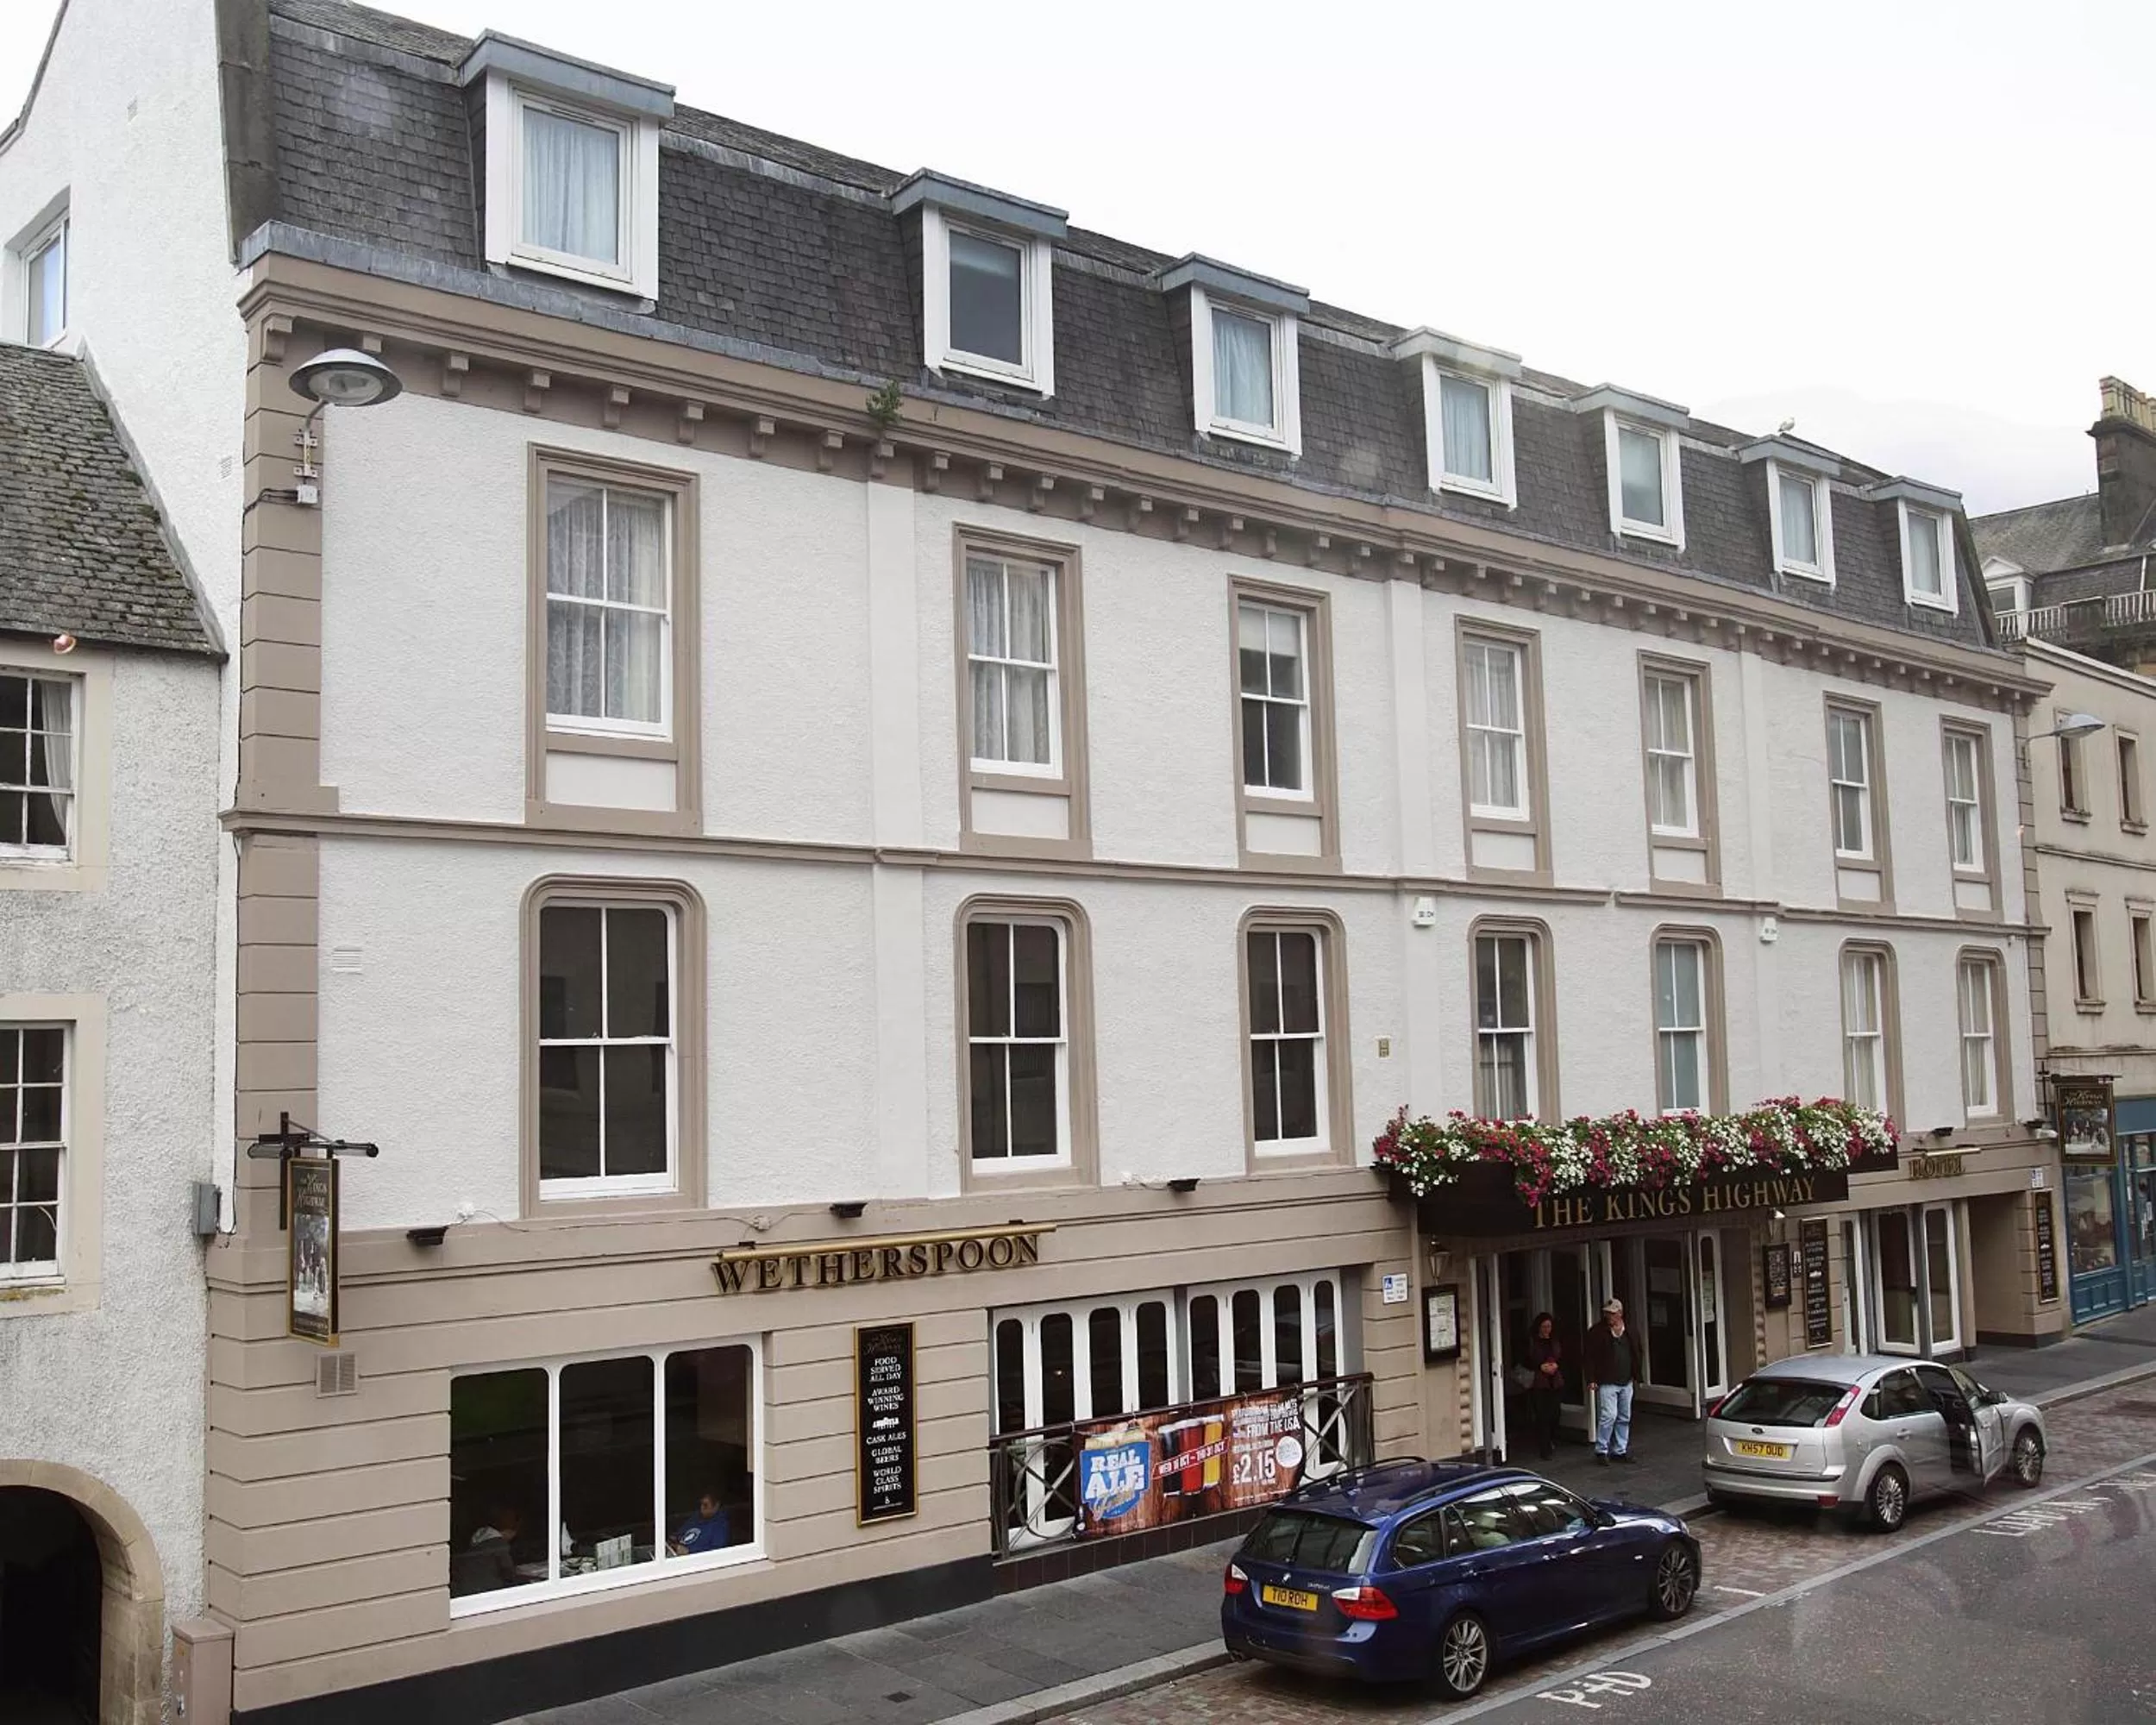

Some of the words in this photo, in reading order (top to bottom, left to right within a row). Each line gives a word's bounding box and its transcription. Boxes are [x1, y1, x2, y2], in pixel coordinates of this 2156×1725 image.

[1533, 1197, 1594, 1228] THE
[1604, 1187, 1691, 1220] KINGS
[1702, 1176, 1814, 1212] HIGHWAY
[711, 1234, 1040, 1293] WETHERSPOON
[874, 1357, 898, 1366] FOOD
[887, 1371, 902, 1380] DAY
[1284, 1415, 1300, 1431] USA
[867, 1434, 886, 1445] CASK
[1091, 1449, 1140, 1472] REAL
[1233, 1449, 1276, 1484] £2.15
[875, 1475, 899, 1485] CLASS
[1085, 1465, 1144, 1499] ALE
